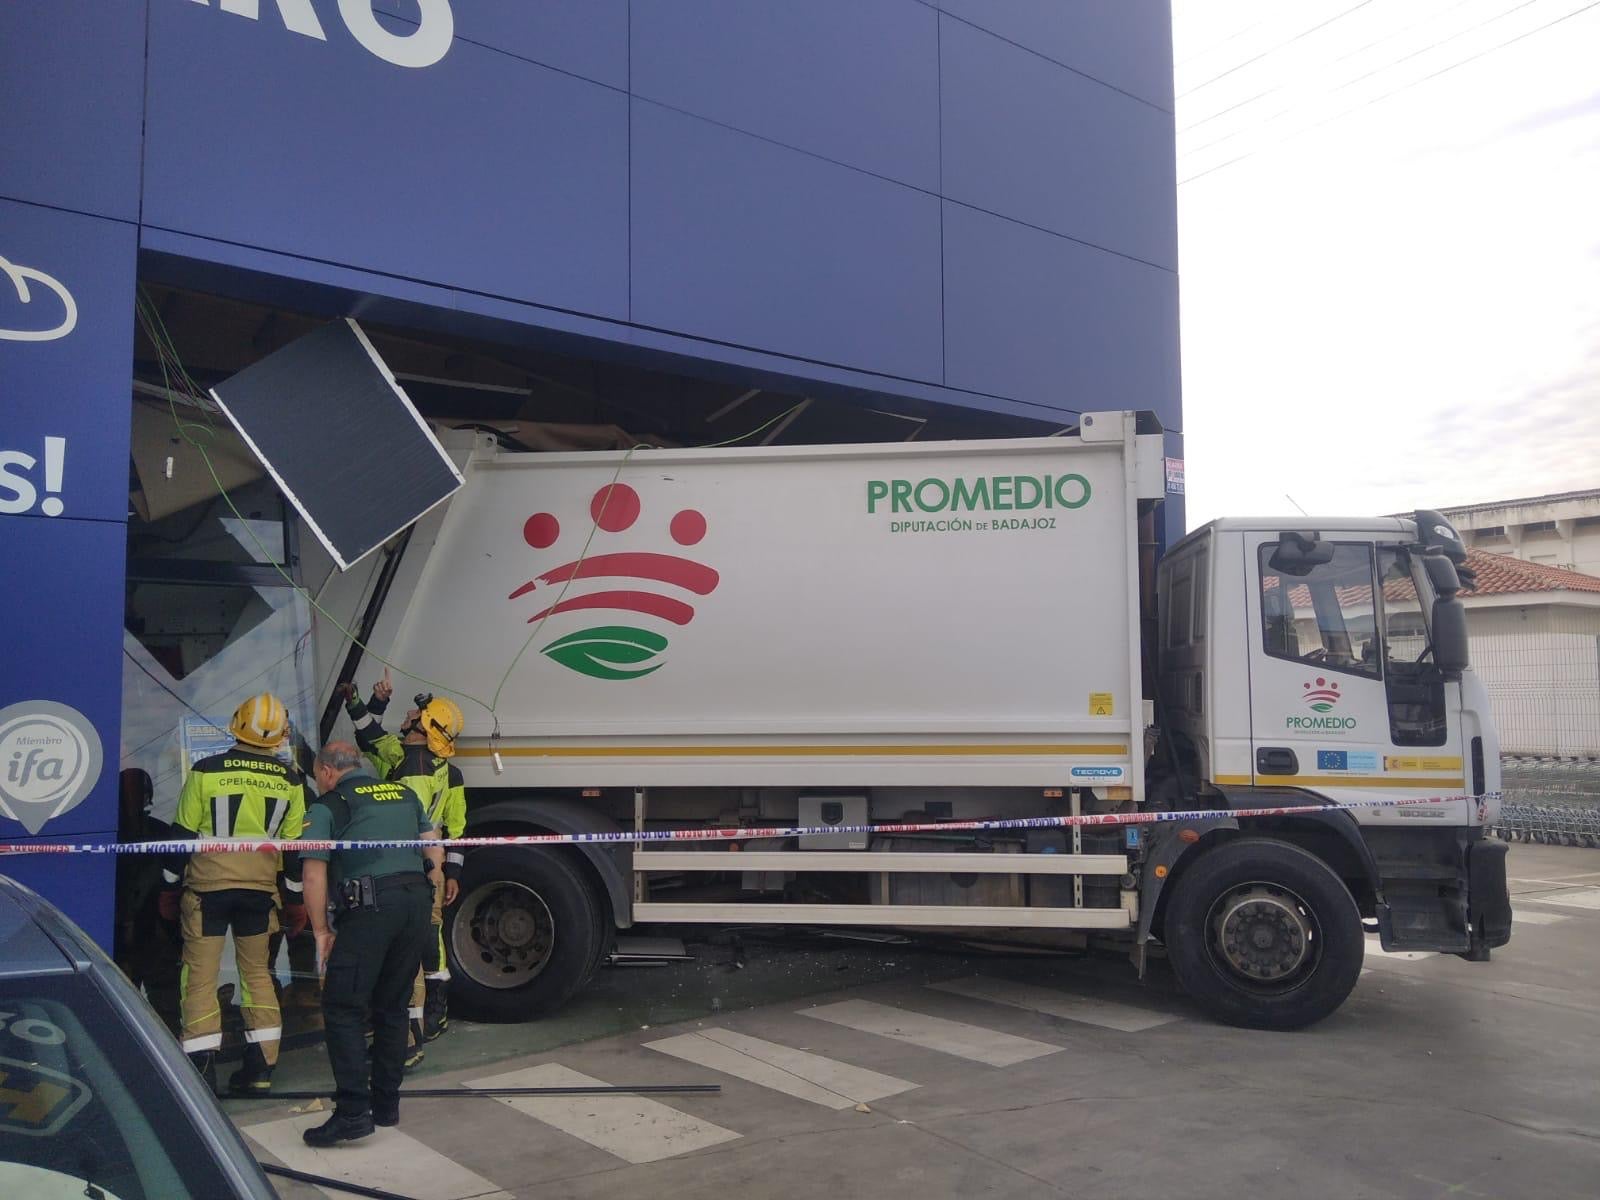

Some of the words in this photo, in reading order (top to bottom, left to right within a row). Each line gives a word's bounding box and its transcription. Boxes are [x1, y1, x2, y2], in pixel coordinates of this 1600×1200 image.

[867, 473, 1092, 514] PROMEDIO
[890, 517, 972, 533] DIPUTACIÓN
[992, 517, 1057, 531] BADAJOZ
[1286, 717, 1357, 729] PROMEDIO
[16, 735, 63, 745] Miembro
[7, 748, 64, 788] ifa
[223, 759, 287, 774] BOMBEROS
[218, 778, 289, 792] CPEI-BADAJOZ
[354, 783, 406, 794] GUARDIA
[372, 791, 404, 801] CIVIL
